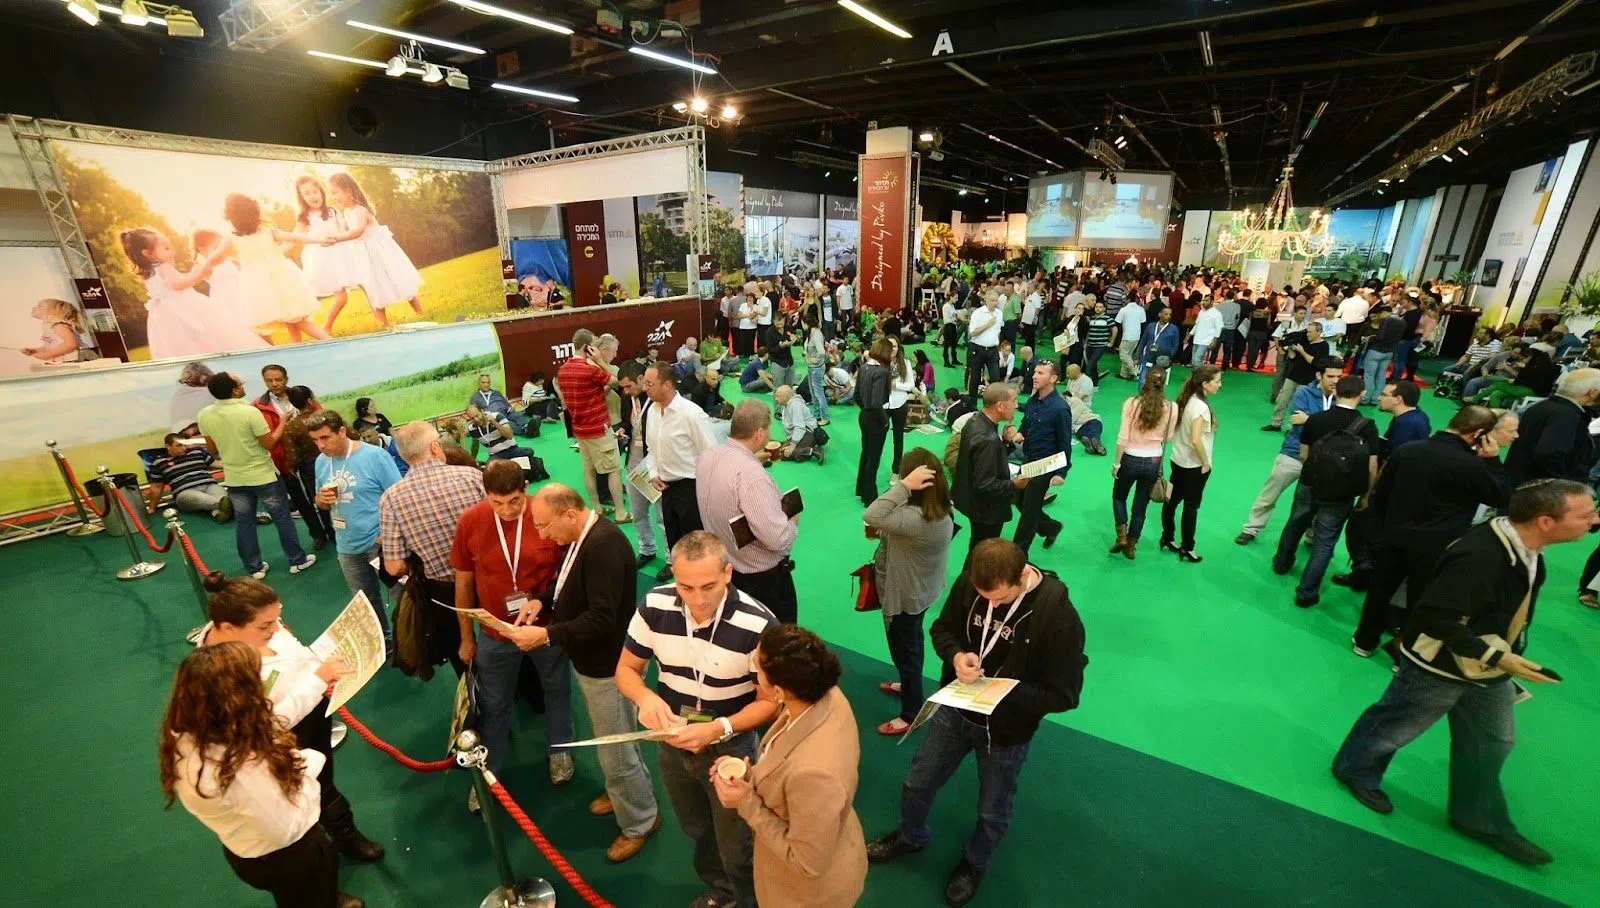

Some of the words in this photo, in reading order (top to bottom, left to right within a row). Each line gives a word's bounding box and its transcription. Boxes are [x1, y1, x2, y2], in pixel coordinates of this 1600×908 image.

[931, 32, 955, 57] A
[871, 201, 885, 227] Pivko
[574, 223, 600, 233] למתחם
[871, 229, 892, 241] by
[576, 233, 600, 241] המכירה
[870, 241, 892, 291] Designed
[551, 343, 576, 359] דהר
